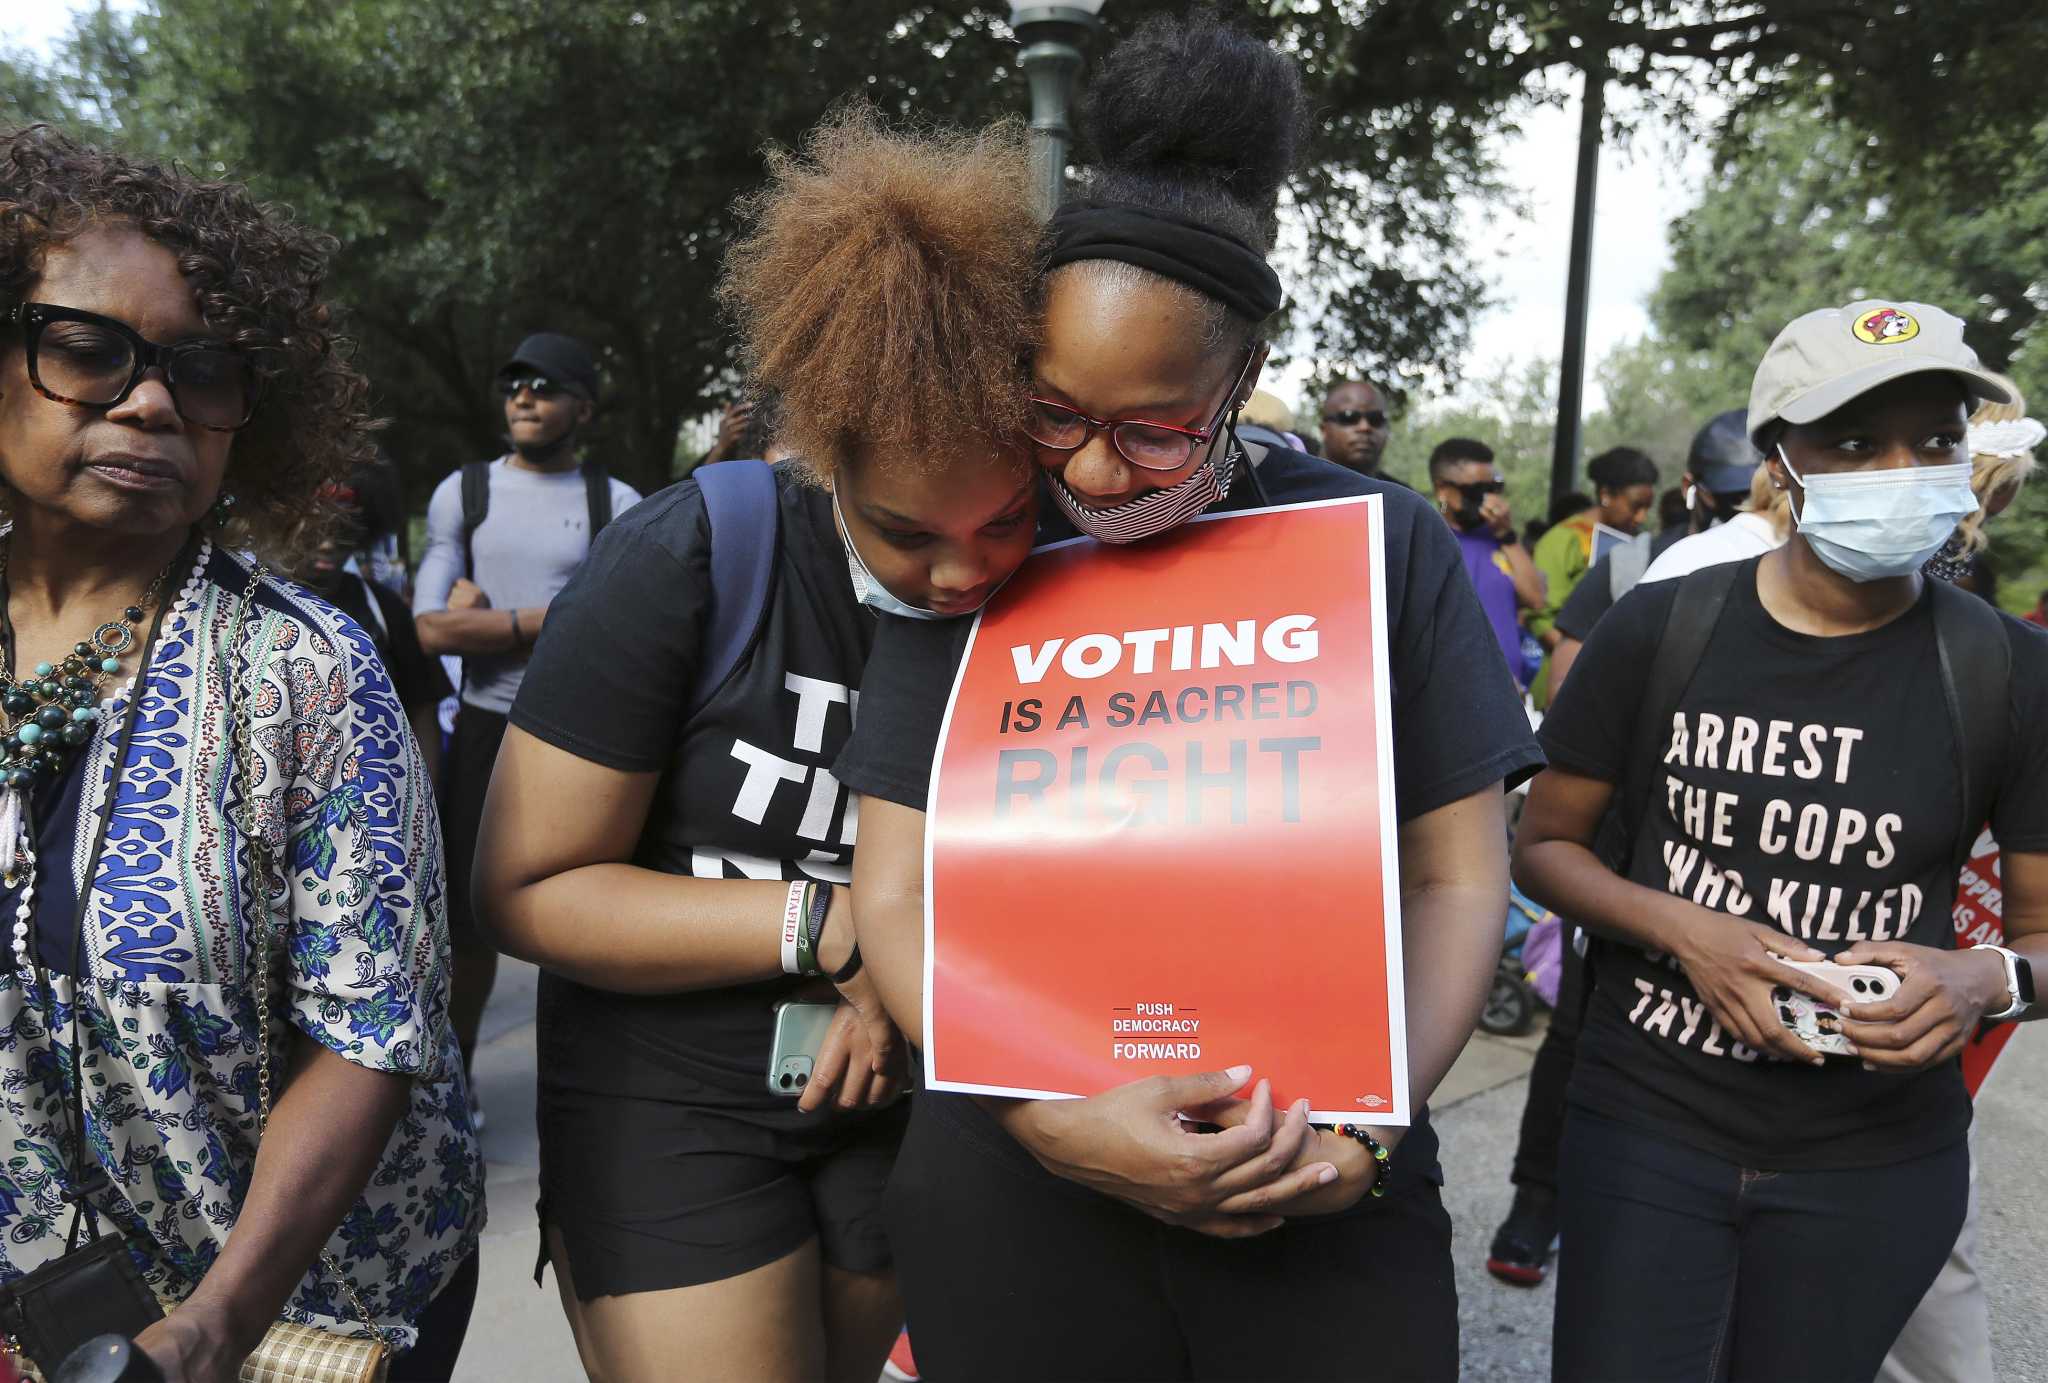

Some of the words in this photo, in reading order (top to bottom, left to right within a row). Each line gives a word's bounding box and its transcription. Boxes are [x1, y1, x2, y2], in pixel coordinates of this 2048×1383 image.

[1010, 614, 1319, 684] VOTING
[999, 698, 1043, 734] IS
[1056, 695, 1090, 731] A
[1106, 680, 1319, 728] SACRED
[1663, 711, 1864, 784] ARREST
[992, 736, 1322, 830] RIGHT
[1665, 775, 1739, 847] THE
[1758, 799, 1903, 869] COPS
[1663, 840, 1753, 916] WHO
[1767, 878, 1924, 942] KILLED
[1952, 904, 1976, 933] IS
[1113, 1019, 1199, 1032] DEMOCRACY
[1136, 1003, 1173, 1016] PUSH
[1113, 1043, 1201, 1060] FORWARD
